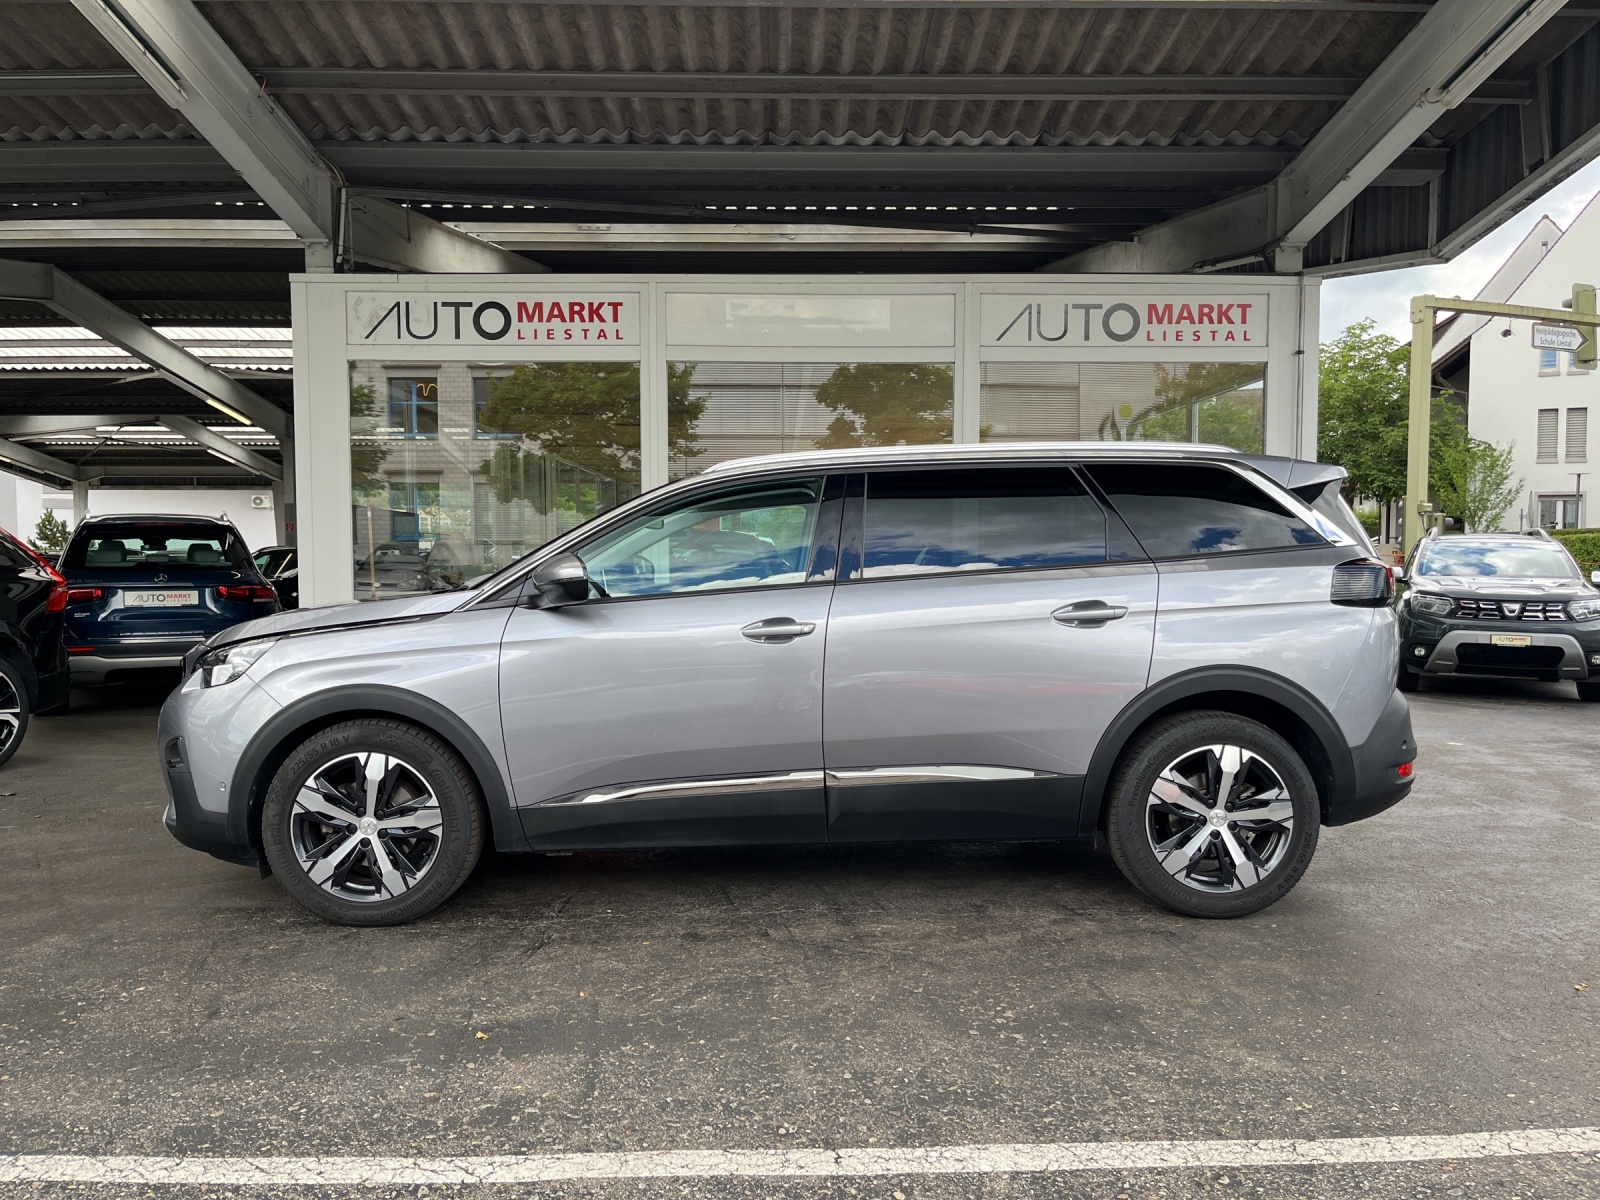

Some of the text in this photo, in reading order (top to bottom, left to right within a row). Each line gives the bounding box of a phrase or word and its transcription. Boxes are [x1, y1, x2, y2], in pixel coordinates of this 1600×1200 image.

[364, 301, 624, 341] AUTO MARKT
[517, 329, 624, 340] LIESTAL
[995, 302, 1252, 342] AUTO MARKT
[1146, 330, 1252, 342] LIESTAL
[1535, 327, 1577, 339] Heilpädagogische
[1540, 337, 1572, 347] Schule Liestal
[132, 593, 166, 603] AUTO
[290, 734, 350, 775] 225/55 R 18 V
[1127, 737, 1182, 808] PremiumContact
[1250, 734, 1303, 784] Continental
[429, 768, 461, 833] Continental
[1276, 831, 1313, 892] 225/55 R 18 V
